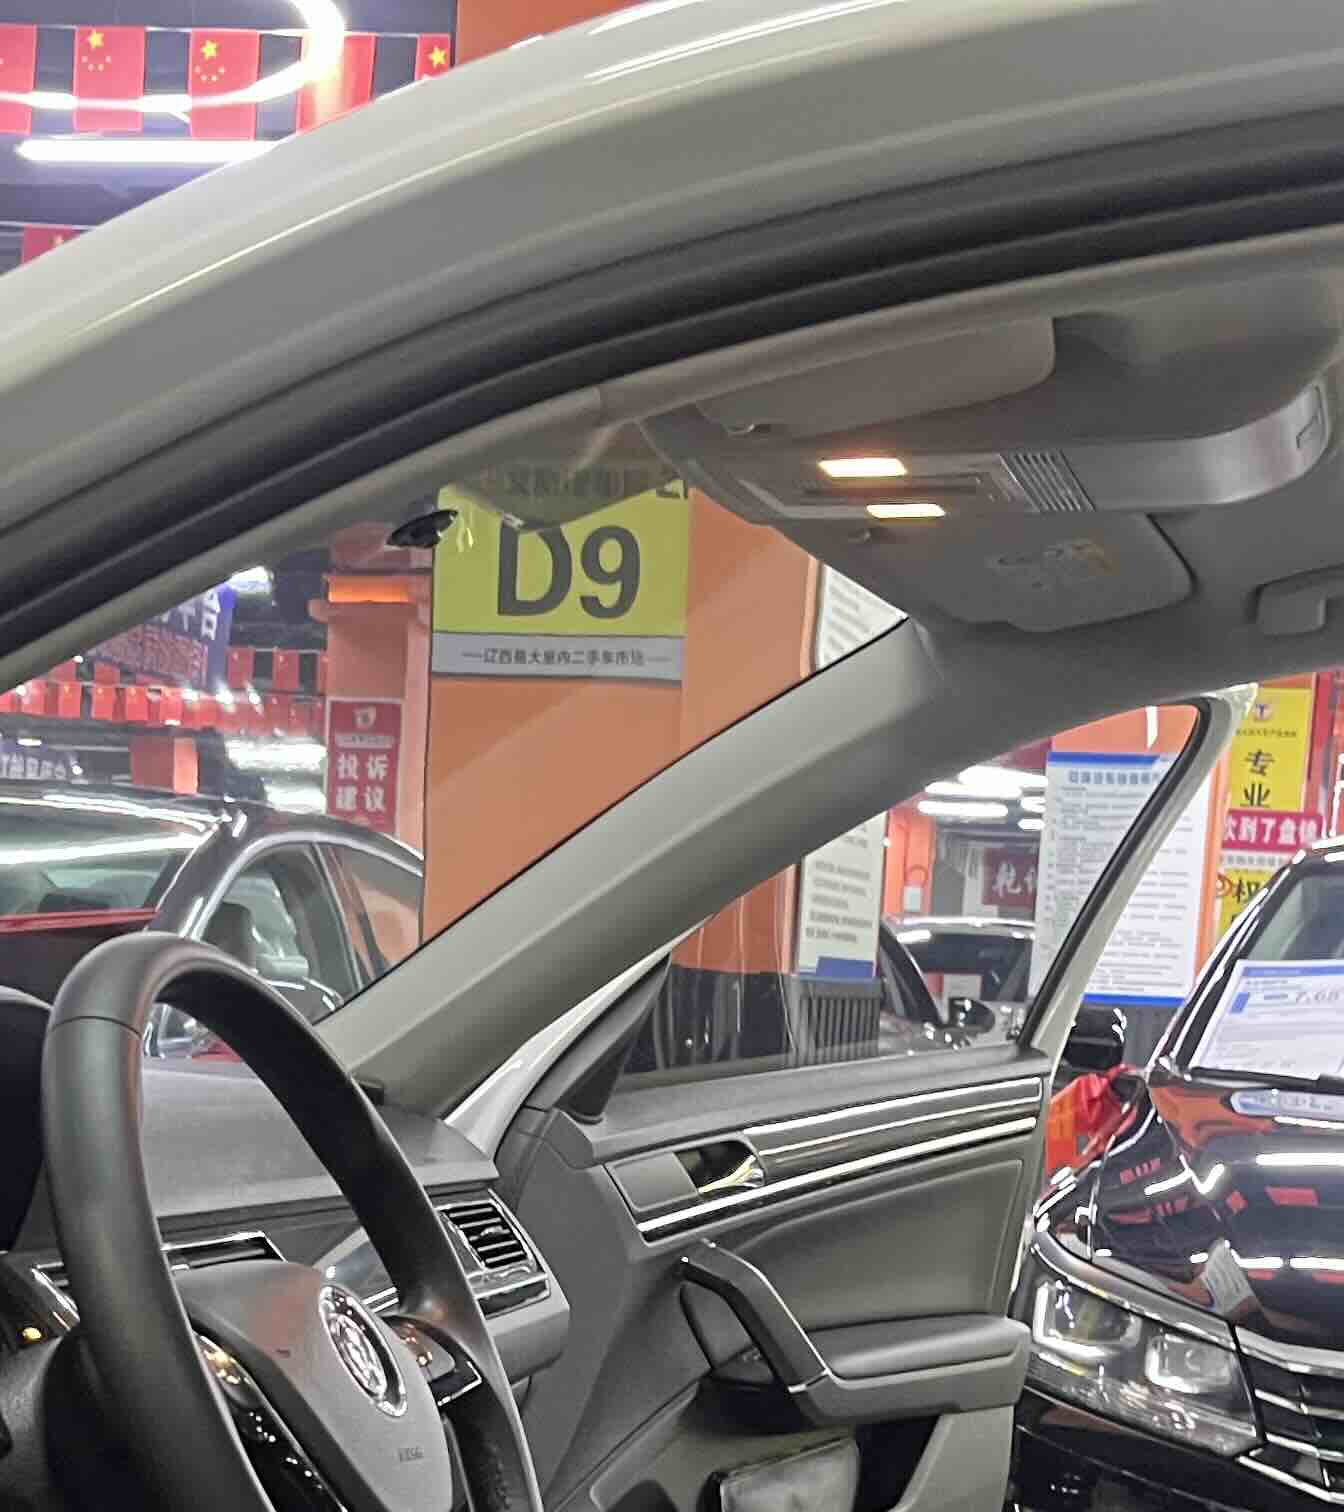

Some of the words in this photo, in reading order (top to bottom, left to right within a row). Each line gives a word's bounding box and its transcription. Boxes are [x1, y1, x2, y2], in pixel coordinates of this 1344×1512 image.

[497, 519, 641, 619] D9
[336, 752, 389, 780] 投诉
[336, 784, 386, 813] 建议
